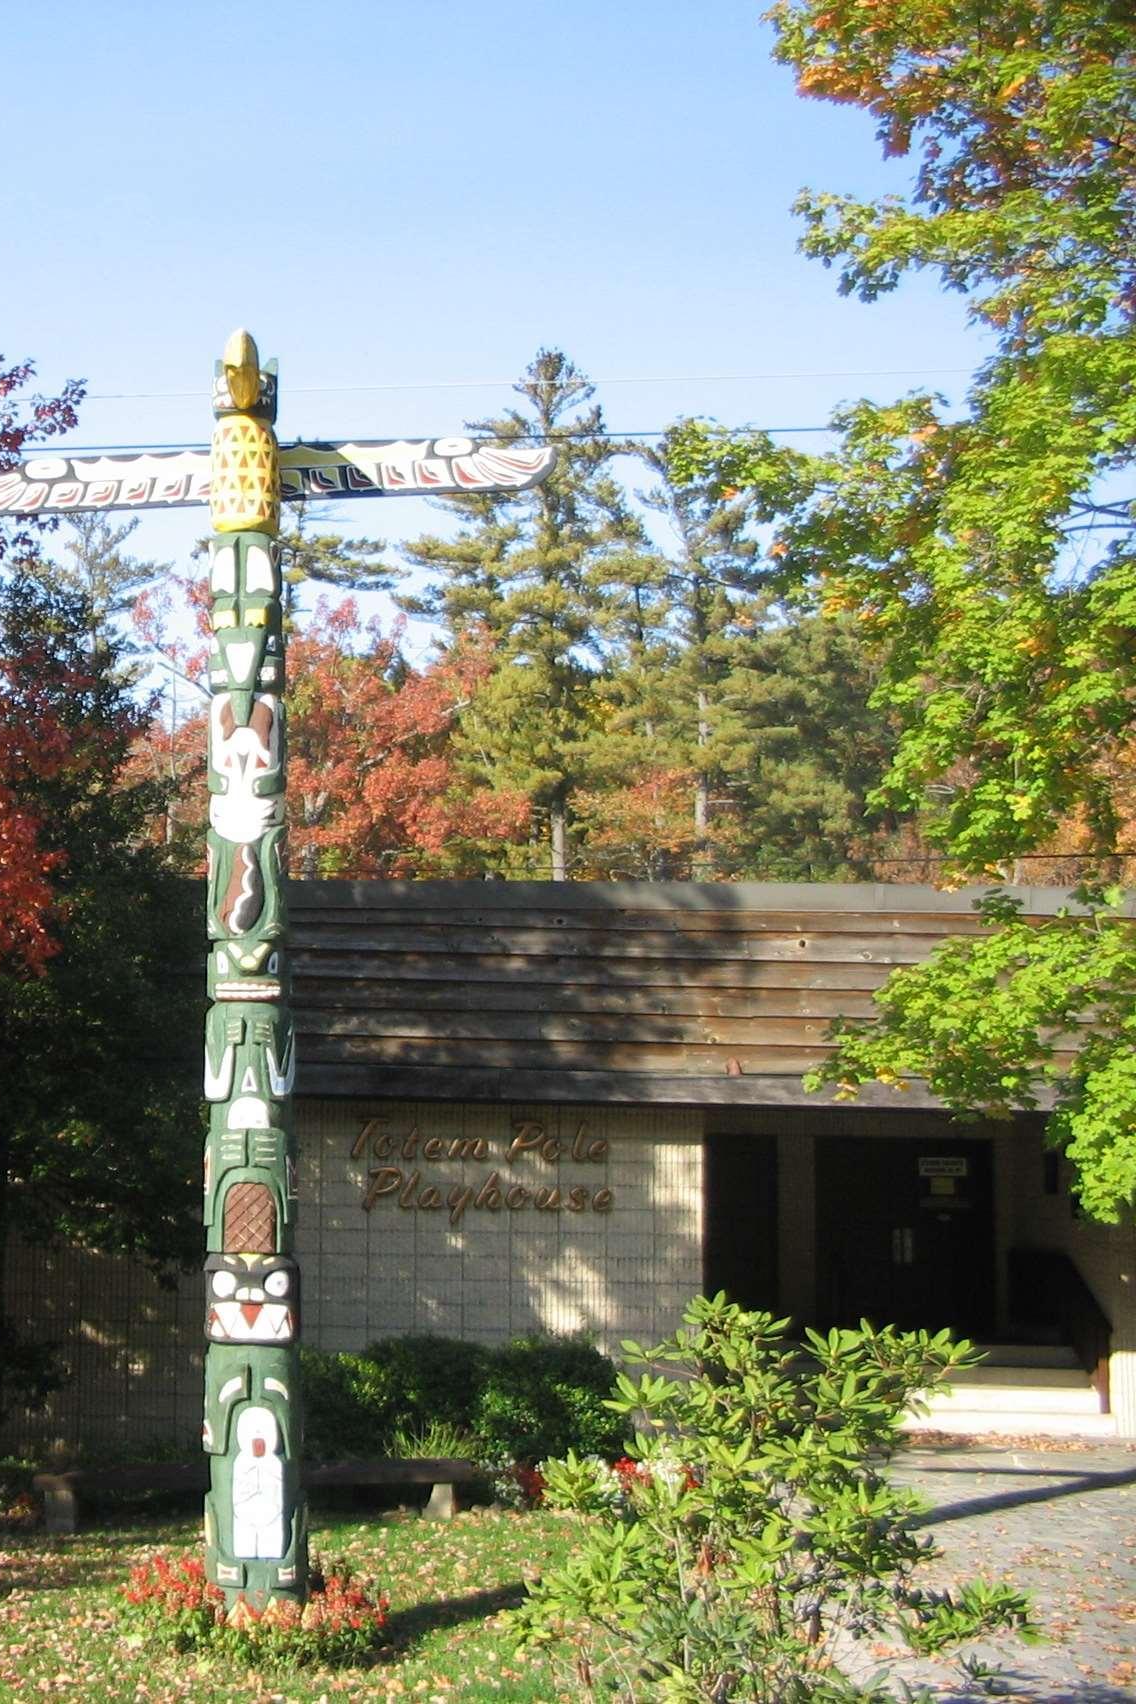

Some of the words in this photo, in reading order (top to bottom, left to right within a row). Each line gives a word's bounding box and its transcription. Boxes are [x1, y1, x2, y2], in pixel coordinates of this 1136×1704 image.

[351, 1117, 492, 1162] Totem
[505, 1121, 610, 1163] Pole
[364, 1166, 614, 1225] Playhouse
